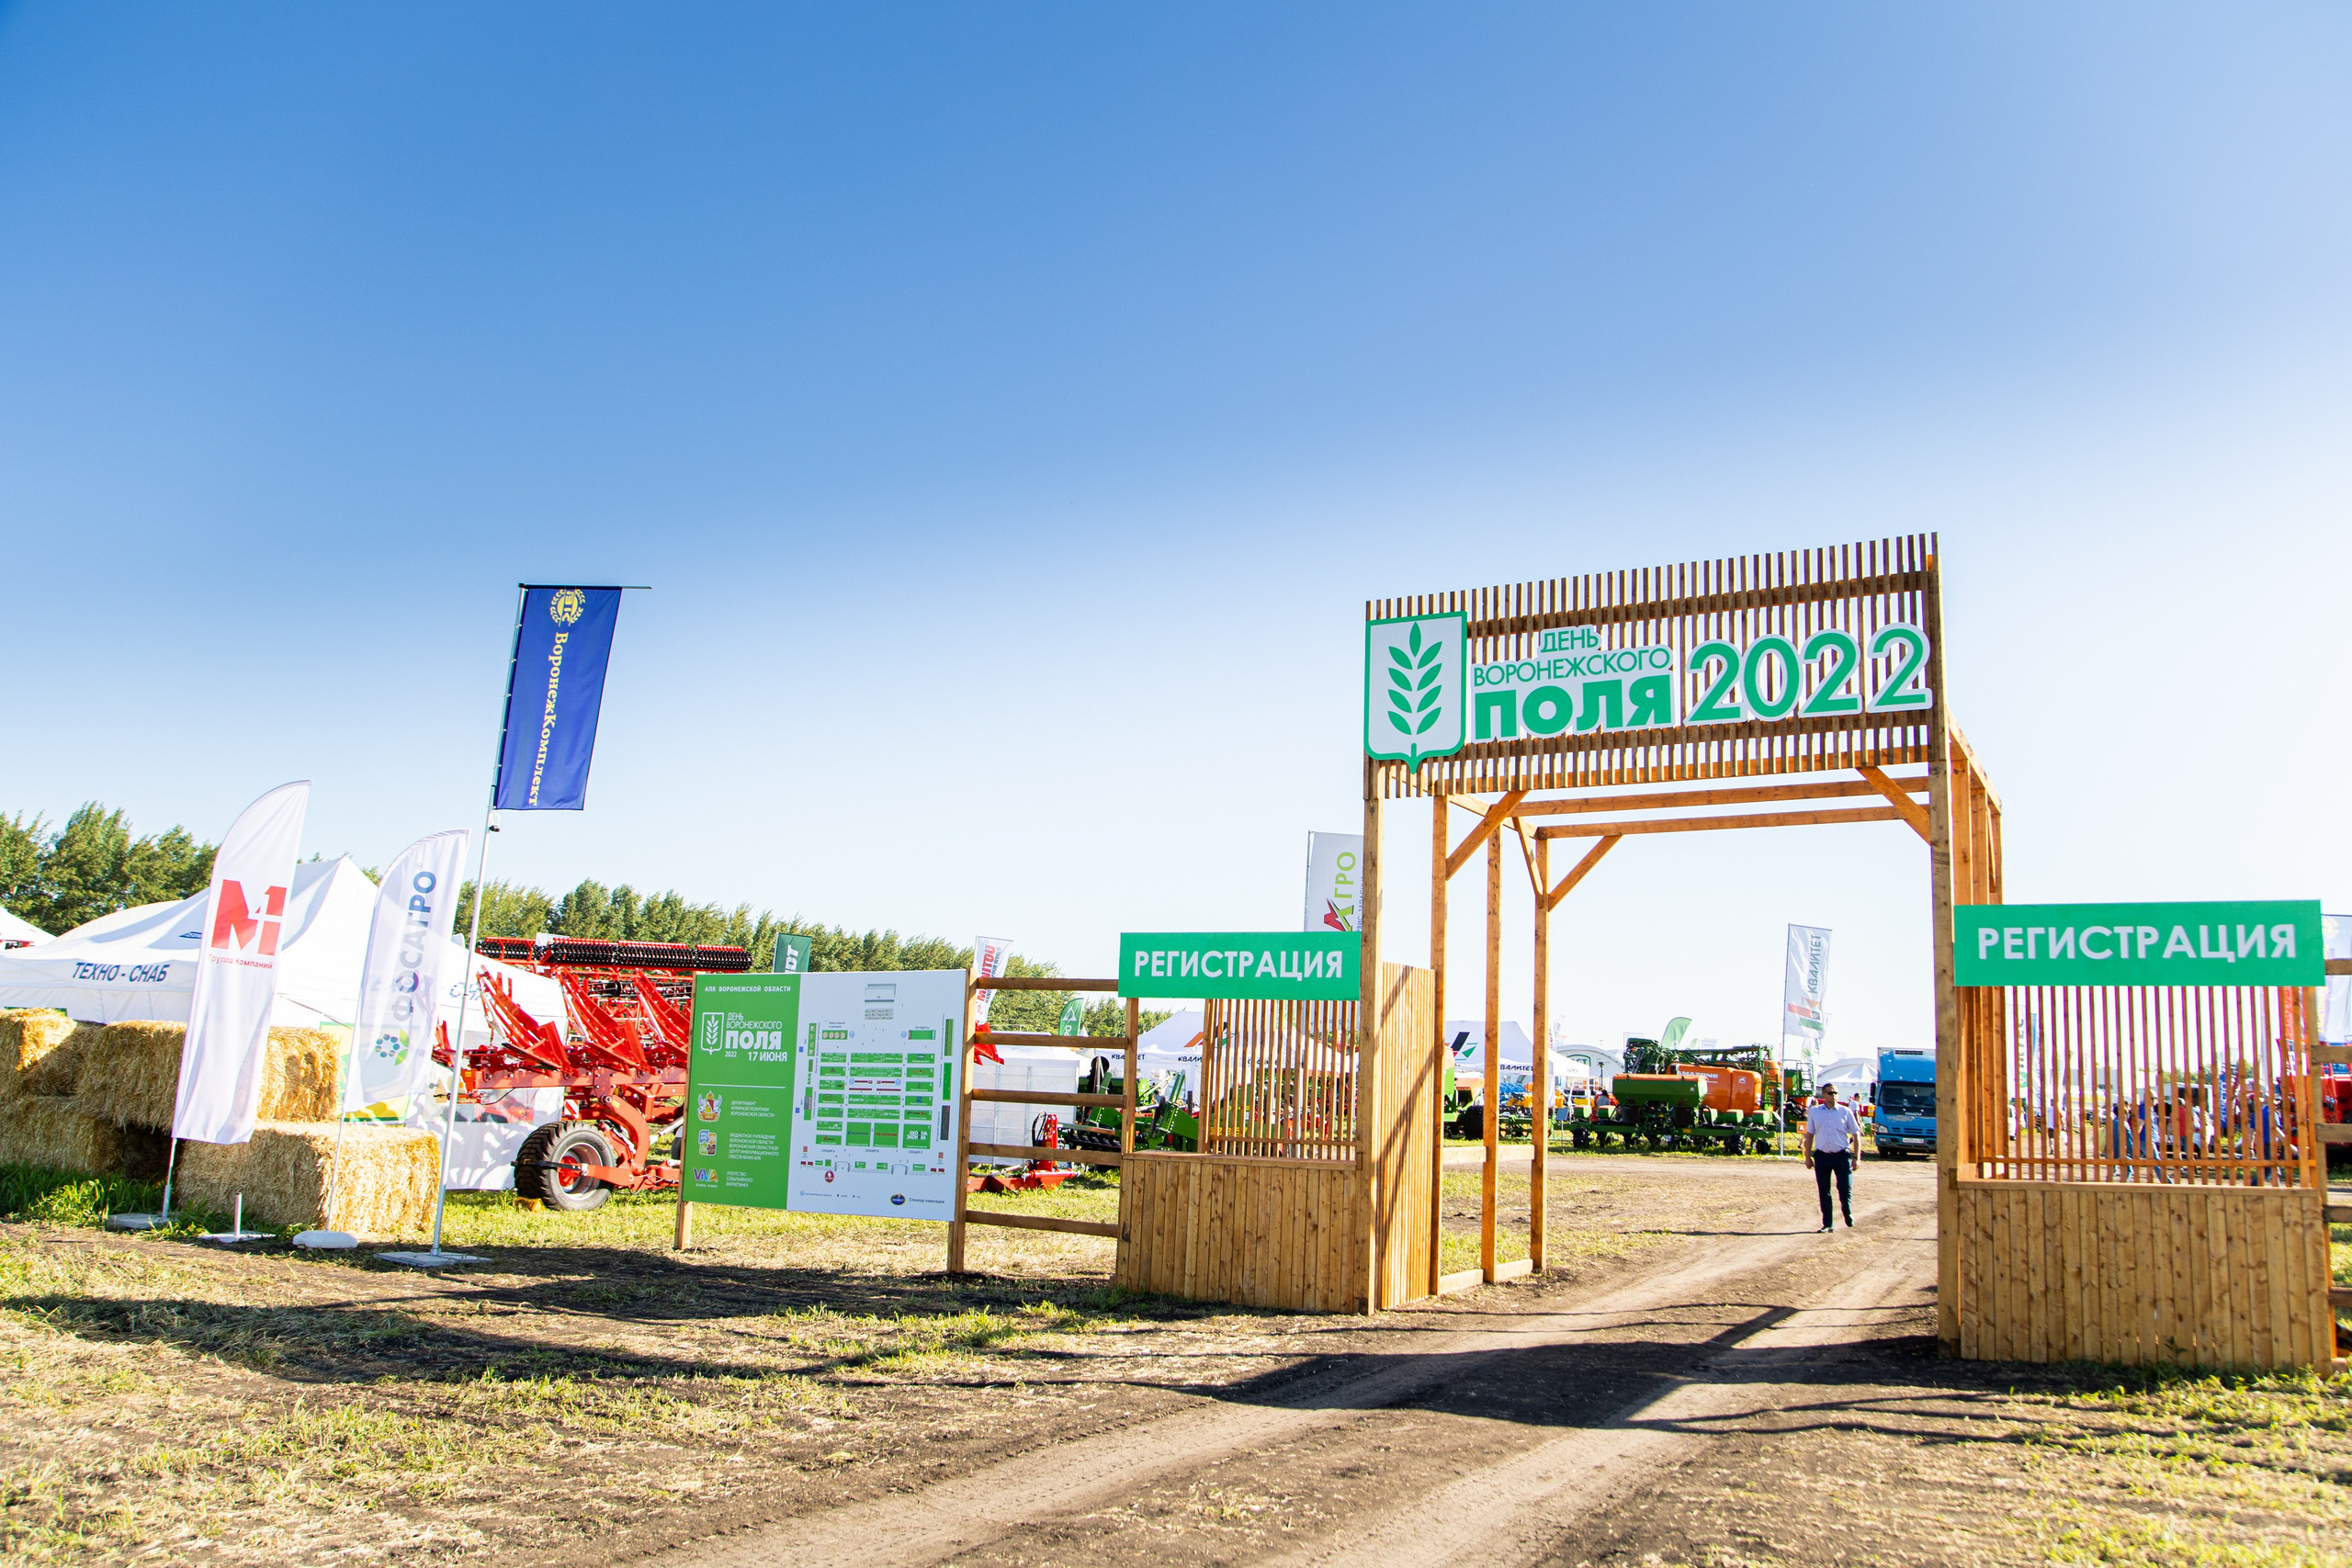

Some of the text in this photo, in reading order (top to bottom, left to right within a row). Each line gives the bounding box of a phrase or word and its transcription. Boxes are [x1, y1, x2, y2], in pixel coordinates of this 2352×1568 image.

[1541, 628, 1600, 653] ДЕНЬ
[1474, 648, 1670, 686] ВОРОНЕЖСКОГО
[1689, 628, 1927, 722] 2022
[528, 632, 569, 806] ВоронежКомплект
[1475, 674, 1672, 739] ПОЛЯ
[209, 954, 273, 970] Группа Компаний
[391, 871, 436, 1021] ФОСАГРО
[1978, 924, 2296, 966] РЕГИСТРАЦИЯ
[72, 962, 120, 981] ТЕХНО
[129, 964, 170, 983] СНАБ
[977, 944, 995, 1002] MNITOU
[1135, 950, 1342, 981] РЕГИСТРАЦИЯ
[1807, 934, 1821, 994] КВАЛИТЕТ
[726, 1021, 782, 1029] ВОРОНЕЖСКОГО
[727, 1012, 743, 1021] ДЕНЬ
[725, 1031, 782, 1050] ПОЛЯ
[748, 1052, 758, 1061] 17
[760, 1052, 787, 1062] ИЮНЯ
